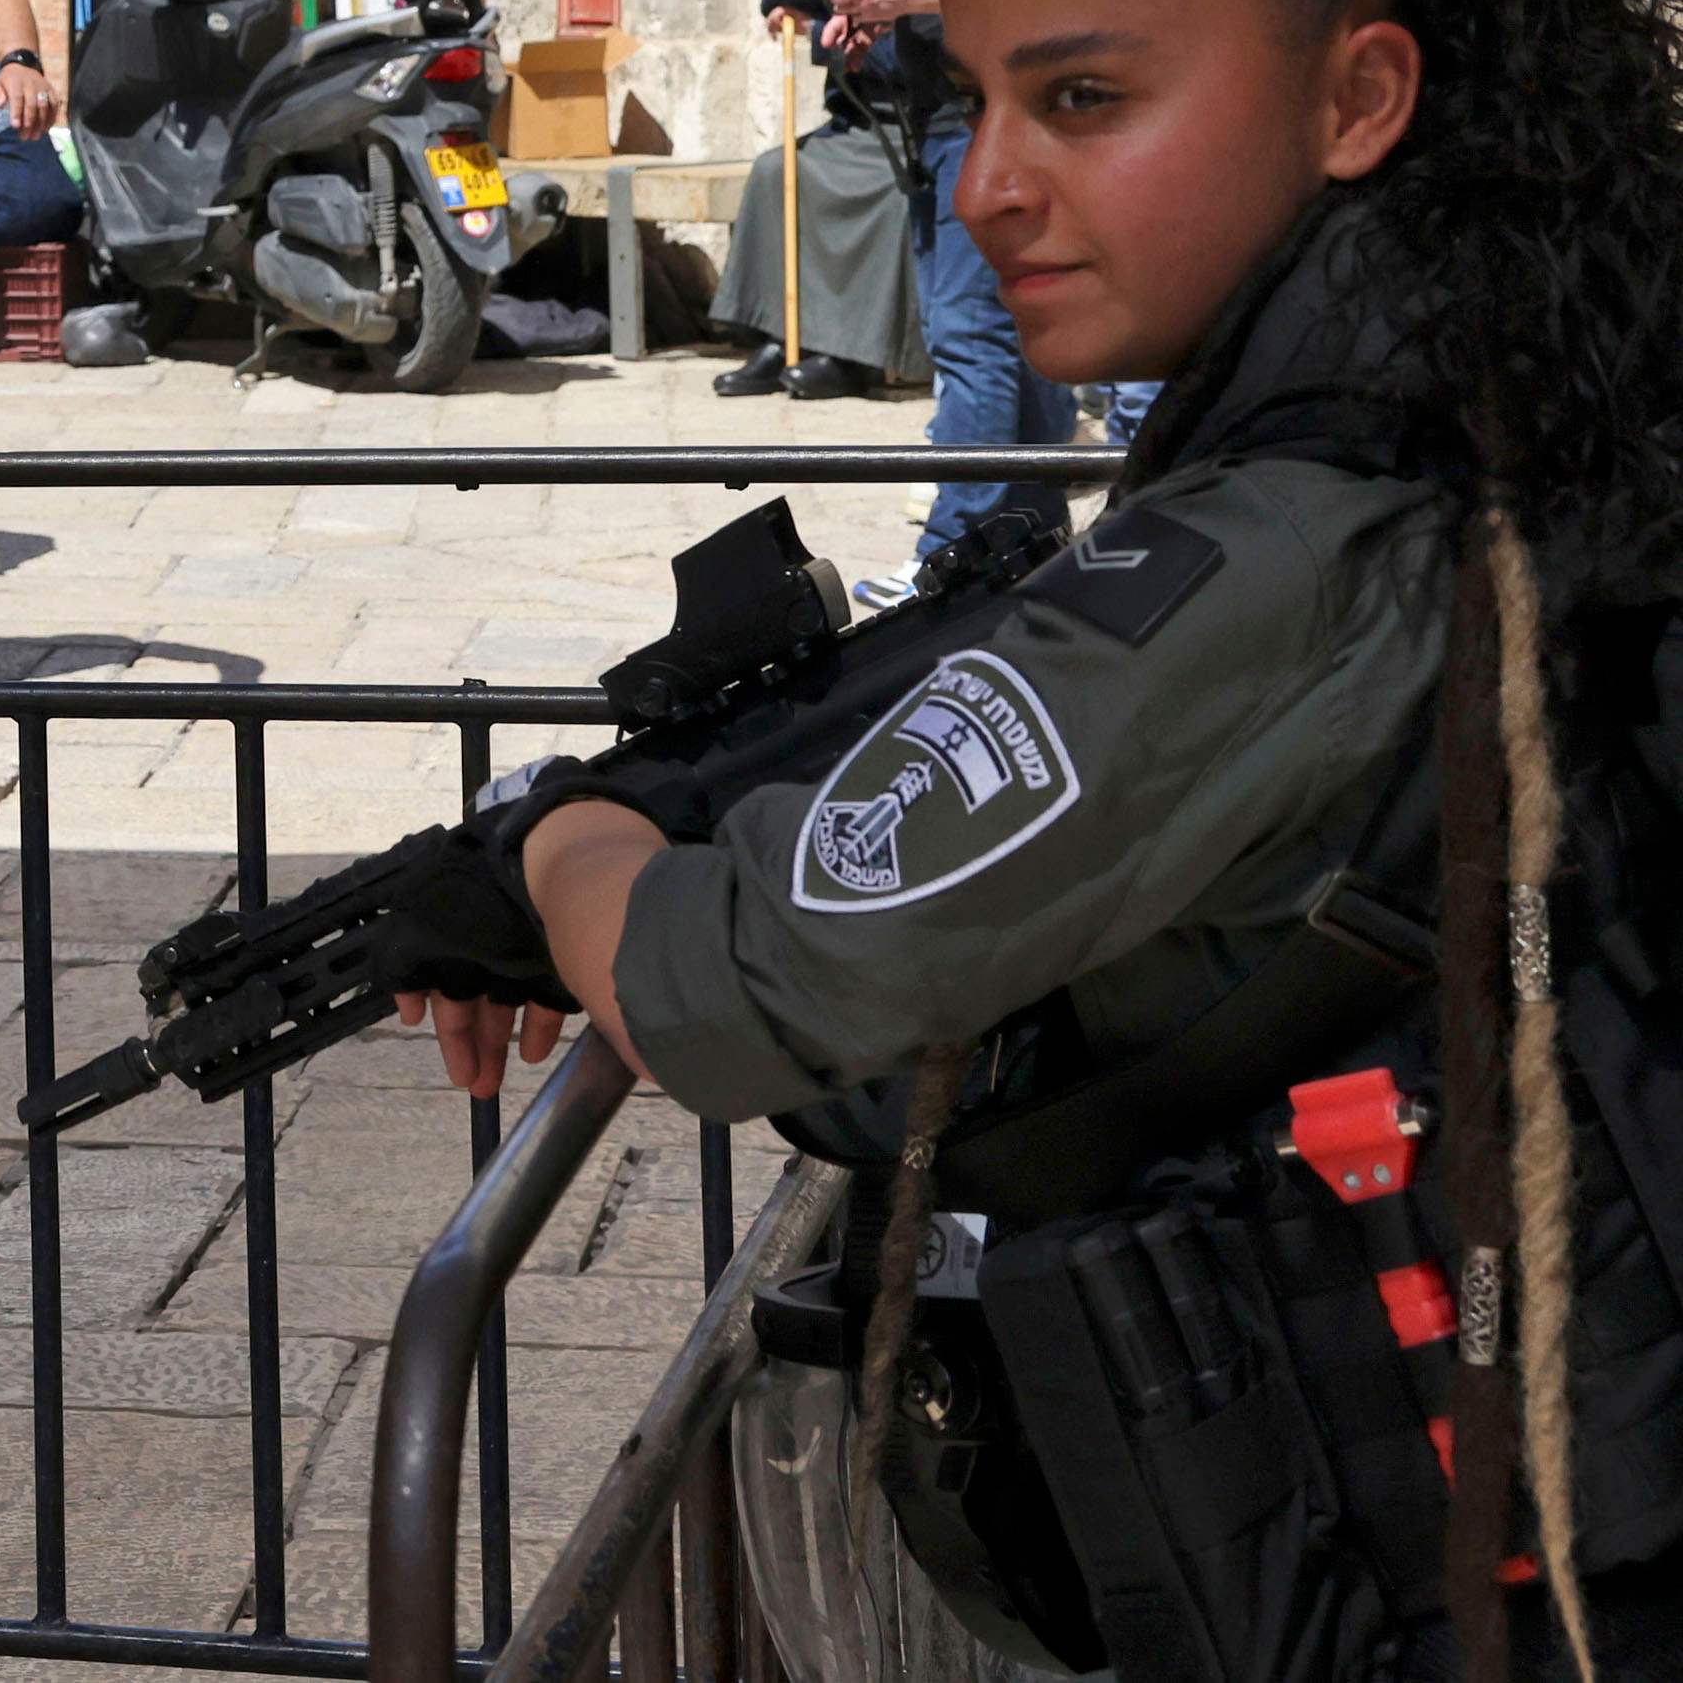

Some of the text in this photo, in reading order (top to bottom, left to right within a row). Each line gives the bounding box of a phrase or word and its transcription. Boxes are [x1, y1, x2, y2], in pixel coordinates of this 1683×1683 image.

[929, 668, 1052, 790] משטרת ישראל
[840, 857, 894, 887] משמר
